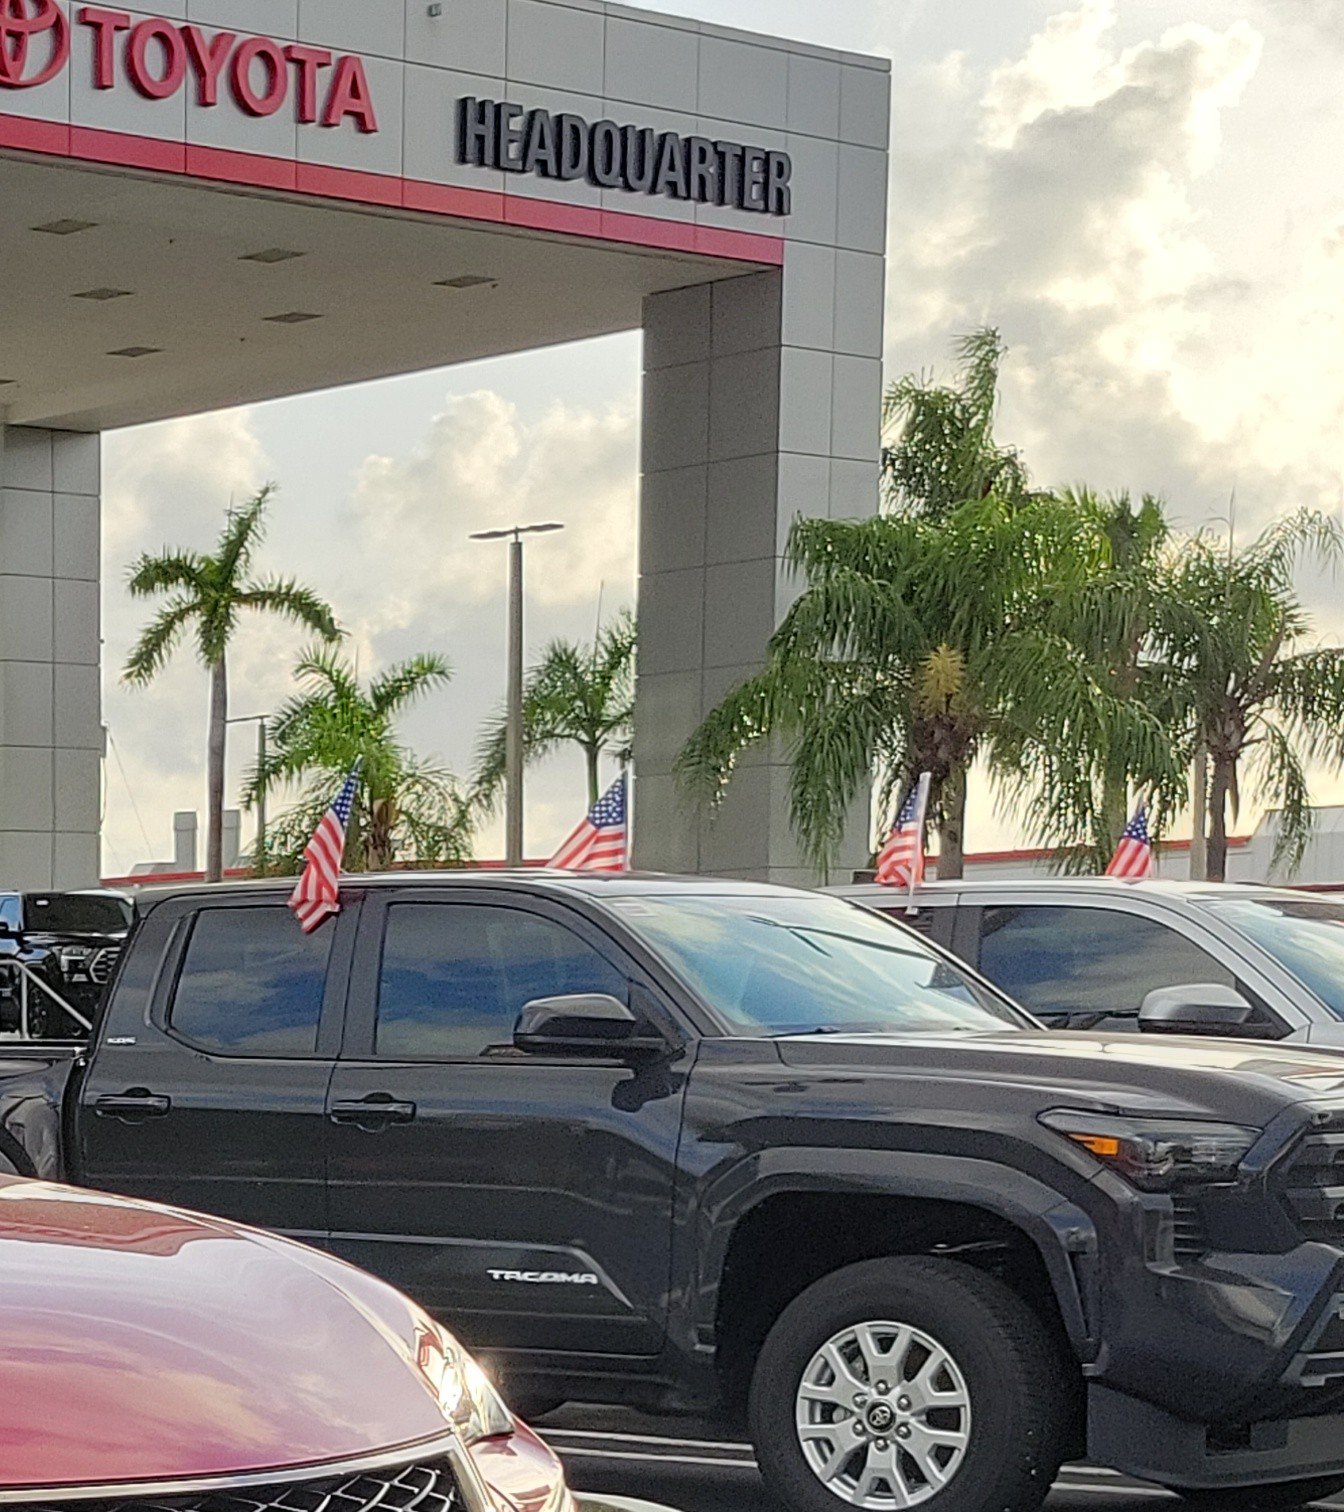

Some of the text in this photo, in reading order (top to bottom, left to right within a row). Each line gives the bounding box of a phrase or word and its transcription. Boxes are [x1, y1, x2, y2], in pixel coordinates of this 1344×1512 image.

[78, 7, 379, 134] TOYOTA
[454, 96, 792, 217] HEADQUARTER
[486, 1269, 599, 1285] TACOMA
